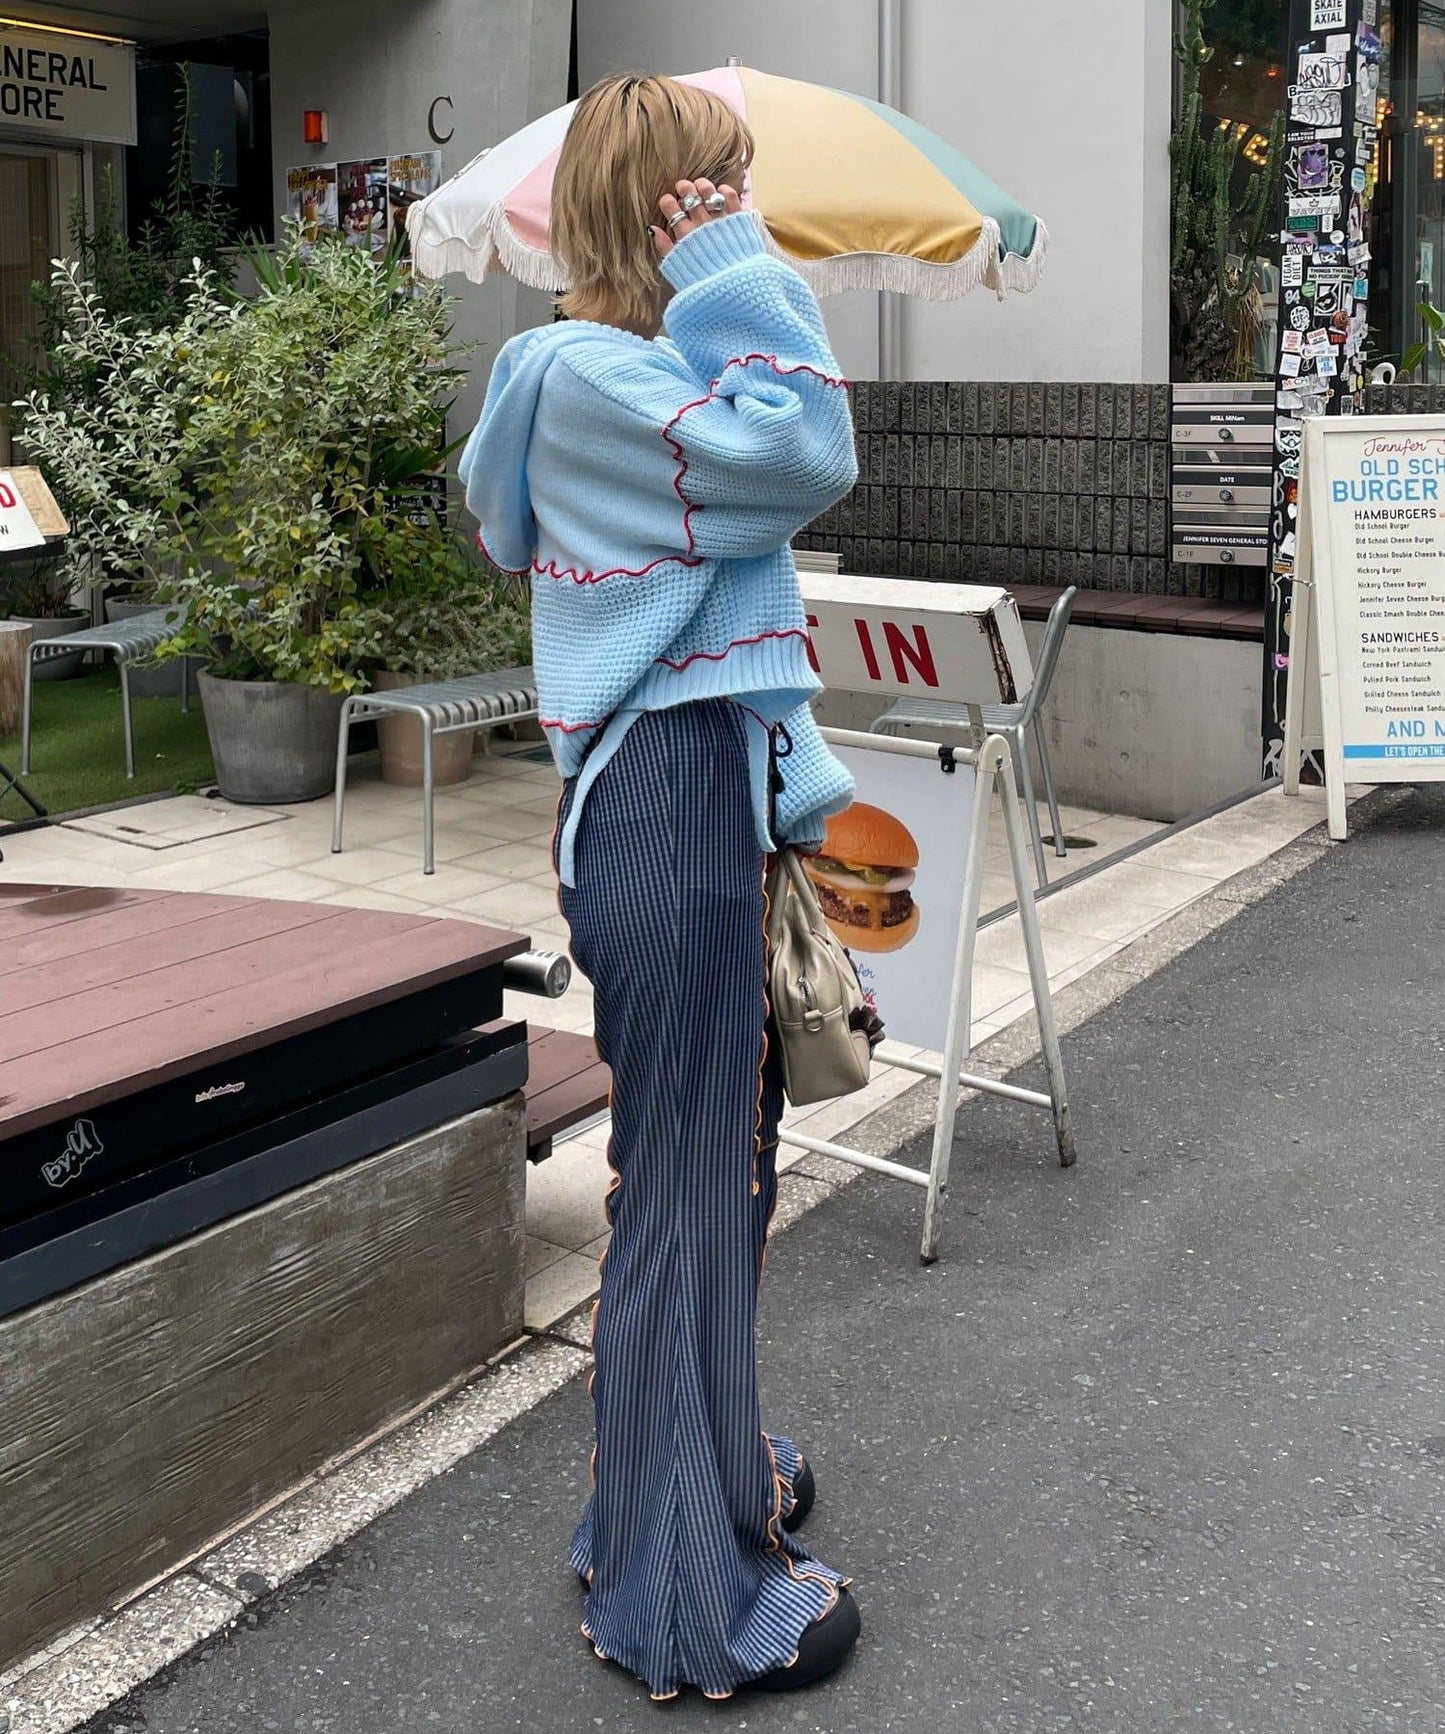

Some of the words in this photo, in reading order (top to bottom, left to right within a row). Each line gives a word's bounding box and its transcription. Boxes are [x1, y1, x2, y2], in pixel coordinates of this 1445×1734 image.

[1314, 12, 1342, 24] AXIAL
[0, 45, 107, 91] NERAL
[1, 83, 64, 121] ORE
[428, 97, 454, 145] C
[1283, 257, 1293, 285] VEGAN
[1292, 262, 1302, 280] DIET
[1364, 436, 1427, 457] Jennifer
[1360, 459, 1399, 476] OLD
[1408, 458, 1445, 475] SCH
[1176, 490, 1193, 498] C-2F
[1332, 479, 1439, 502] BURGER
[1354, 508, 1437, 520] HAMBURGERS
[1367, 522, 1388, 530] School
[1390, 522, 1410, 530] Burger
[1390, 536, 1412, 544] Cheese
[1414, 536, 1435, 544] Burger
[1391, 551, 1412, 559] Double
[1382, 567, 1402, 575] Burger
[1407, 581, 1427, 589] Burger
[1361, 632, 1439, 643] SANDWICHES
[854, 618, 939, 687] IN
[1402, 660, 1432, 668] Sandwich
[1365, 706, 1383, 714] Philly
[1387, 720, 1425, 737] AND
[1407, 746, 1429, 757] OPEN
[1429, 746, 1445, 756] THE
